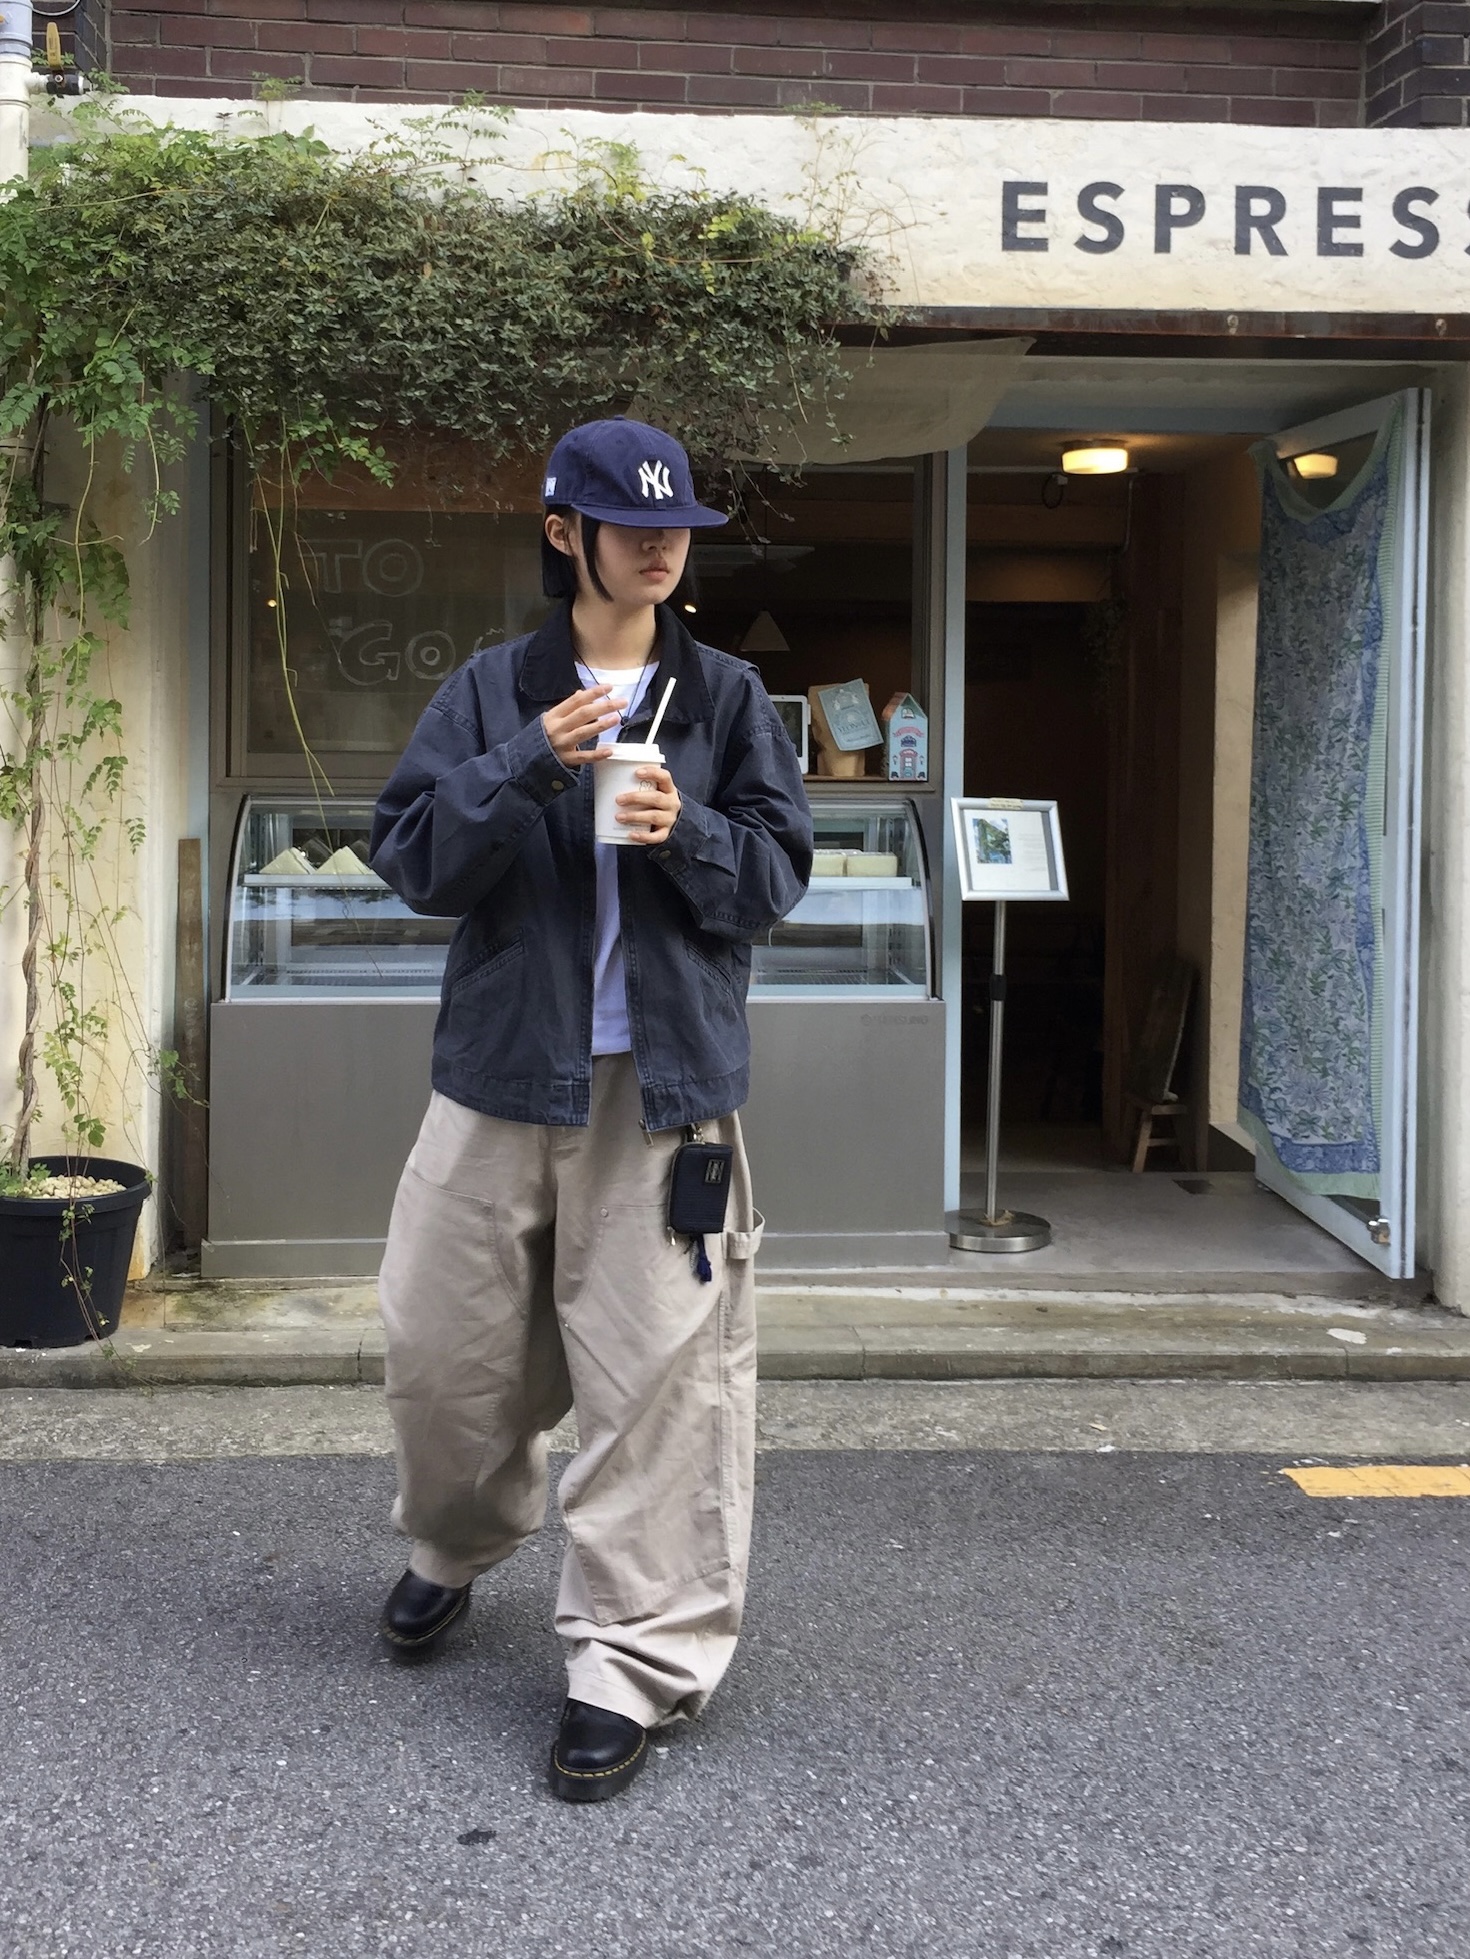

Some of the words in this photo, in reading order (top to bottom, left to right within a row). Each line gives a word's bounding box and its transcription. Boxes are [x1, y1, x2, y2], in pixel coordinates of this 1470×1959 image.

[638, 460, 674, 500] NY
[299, 538, 424, 597] TO
[339, 619, 457, 687] GO
